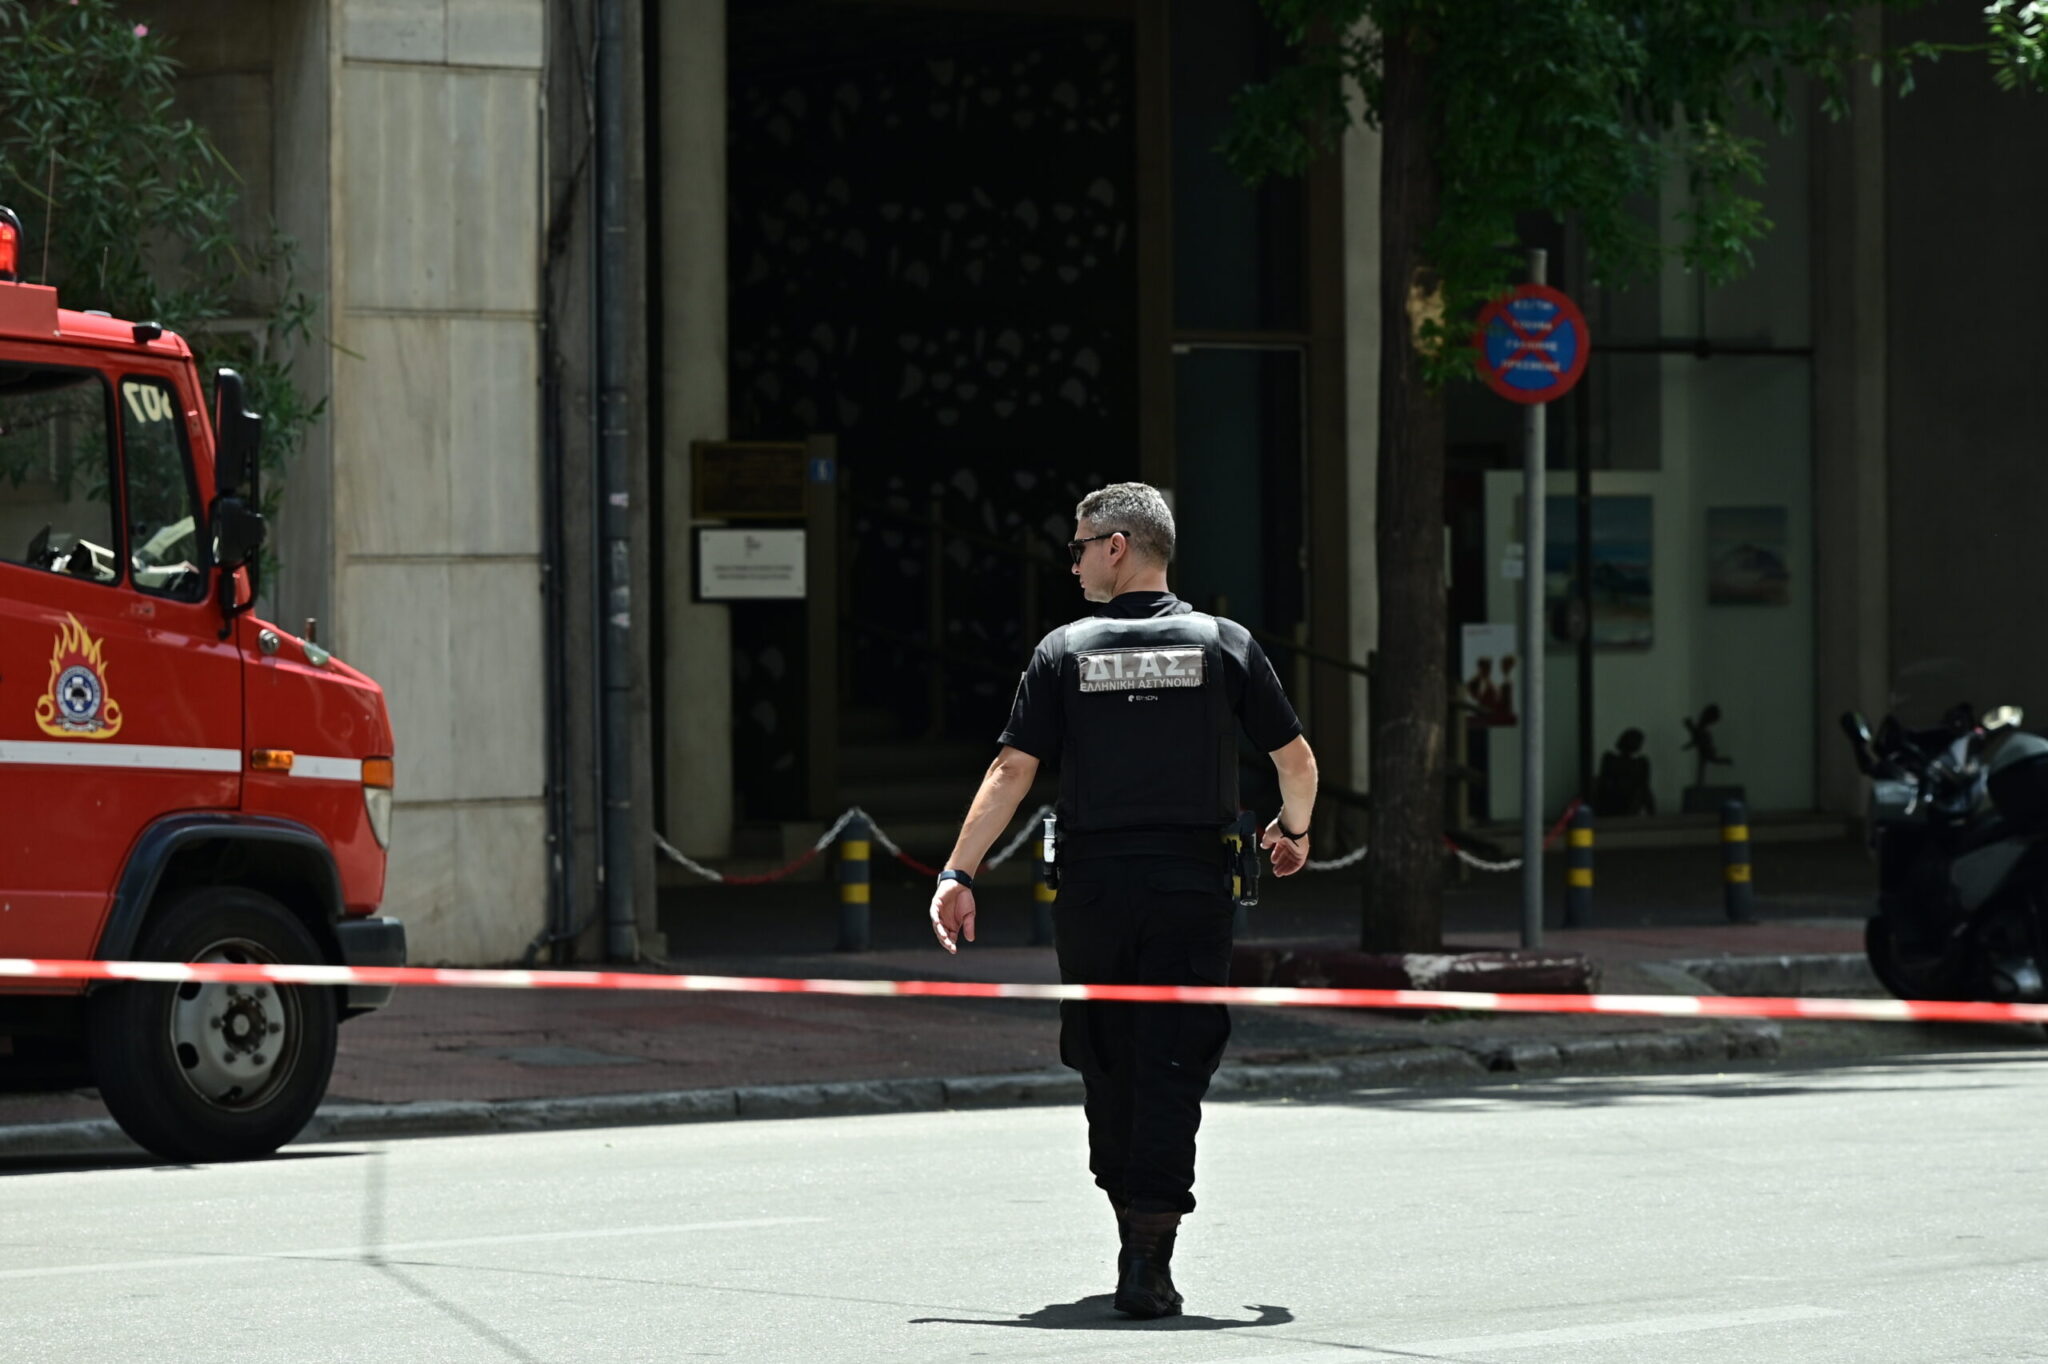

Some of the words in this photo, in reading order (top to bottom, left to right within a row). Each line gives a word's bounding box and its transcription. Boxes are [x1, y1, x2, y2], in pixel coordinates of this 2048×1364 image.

[1085, 652, 1197, 681] ΔΙ.ΑΣ.
[1080, 680, 1135, 691] ΕΛΛΗΝΙΚΗ
[1138, 677, 1201, 689] ΑΣΤΥΝΟΜΙΑ
